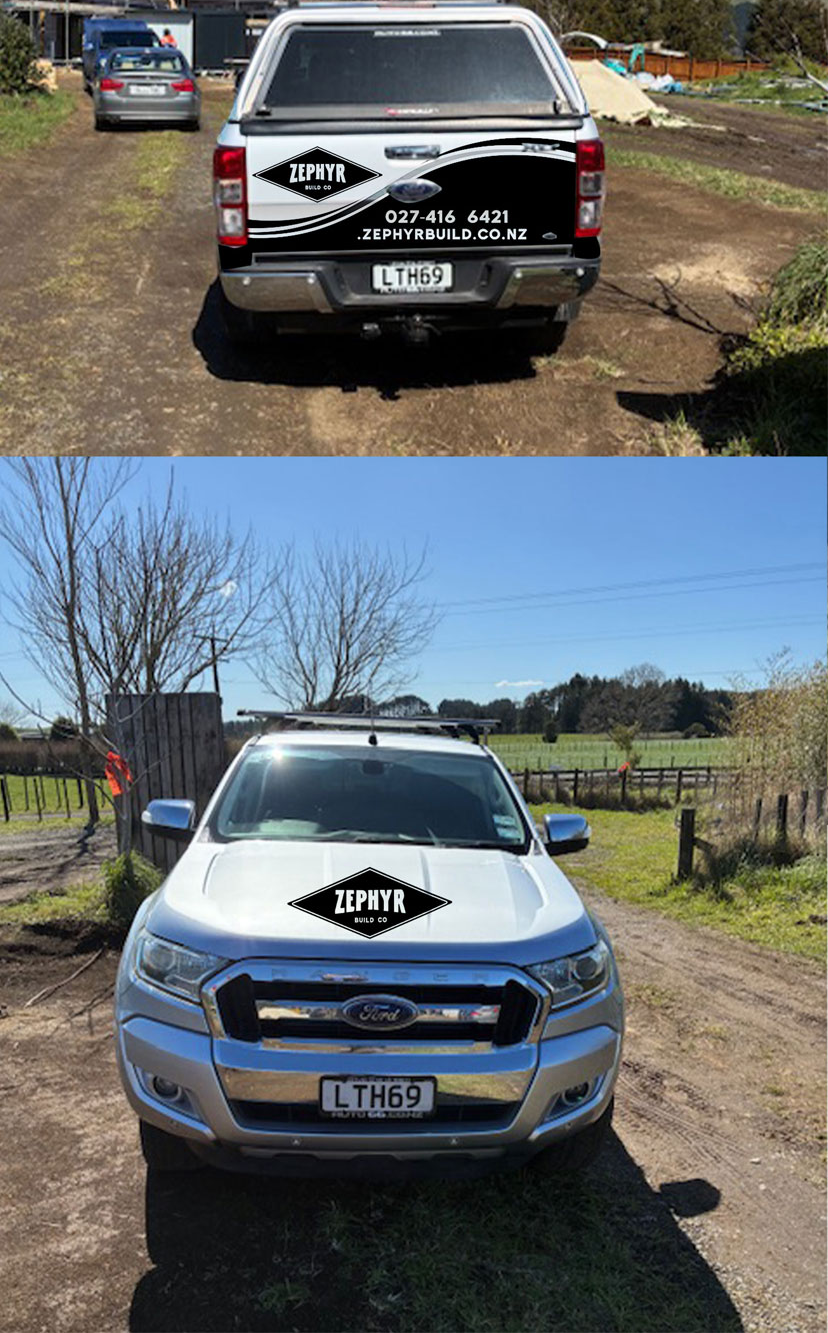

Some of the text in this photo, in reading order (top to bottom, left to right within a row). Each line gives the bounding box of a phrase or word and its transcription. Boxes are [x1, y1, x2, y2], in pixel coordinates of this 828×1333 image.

[289, 163, 346, 183] ZEPHYR
[385, 210, 509, 224] 027-416 6421
[382, 266, 444, 286] LTH69
[334, 889, 406, 914] ZEPHYR
[359, 1004, 400, 1022] Ford
[335, 1085, 421, 1108] LTH69
